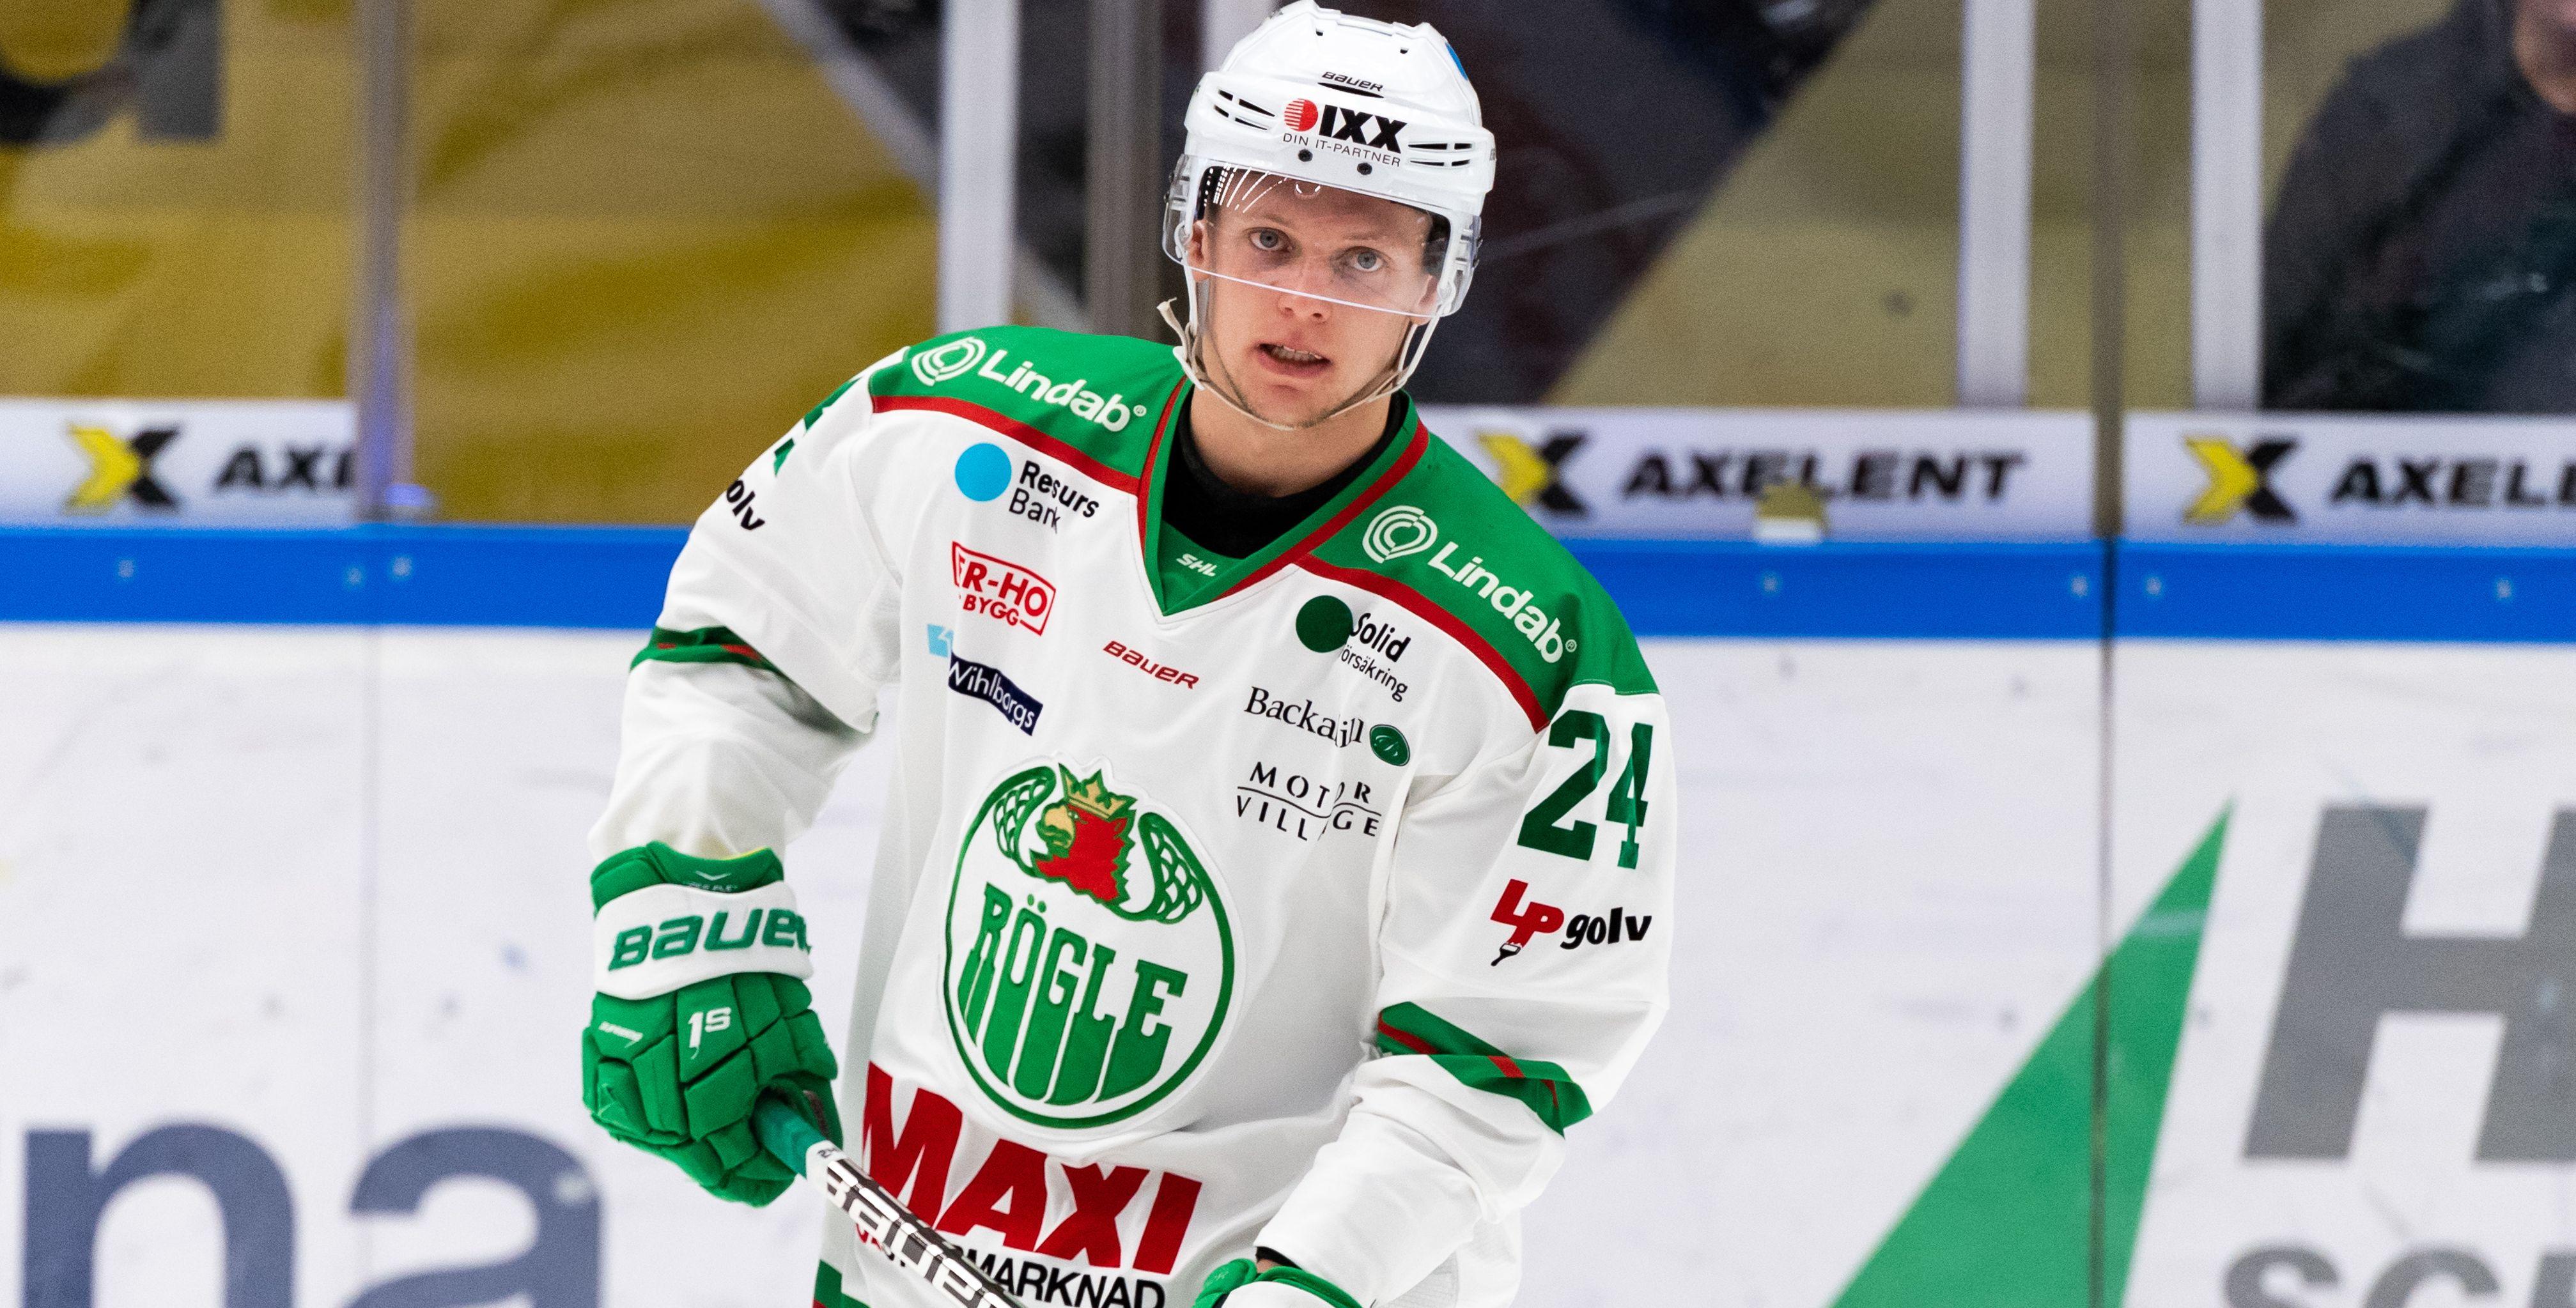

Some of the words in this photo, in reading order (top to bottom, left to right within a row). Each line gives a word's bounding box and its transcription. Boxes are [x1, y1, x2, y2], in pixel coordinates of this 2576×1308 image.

[1282, 133, 1309, 147] DIN
[1315, 139, 1401, 167] IT-PARTNER
[1019, 460, 1099, 518] Resurs
[1622, 451, 2026, 500] AXELENT
[1176, 553, 1216, 577] SHL
[963, 594, 1020, 626] BYGG
[1349, 612, 1411, 663] Solid
[949, 660, 1035, 728] Wihlborgs
[1517, 709, 1654, 870] 24
[1560, 907, 1652, 950] golv
[958, 882, 1189, 1105] RÖGLE
[863, 1061, 1203, 1275] MAXI
